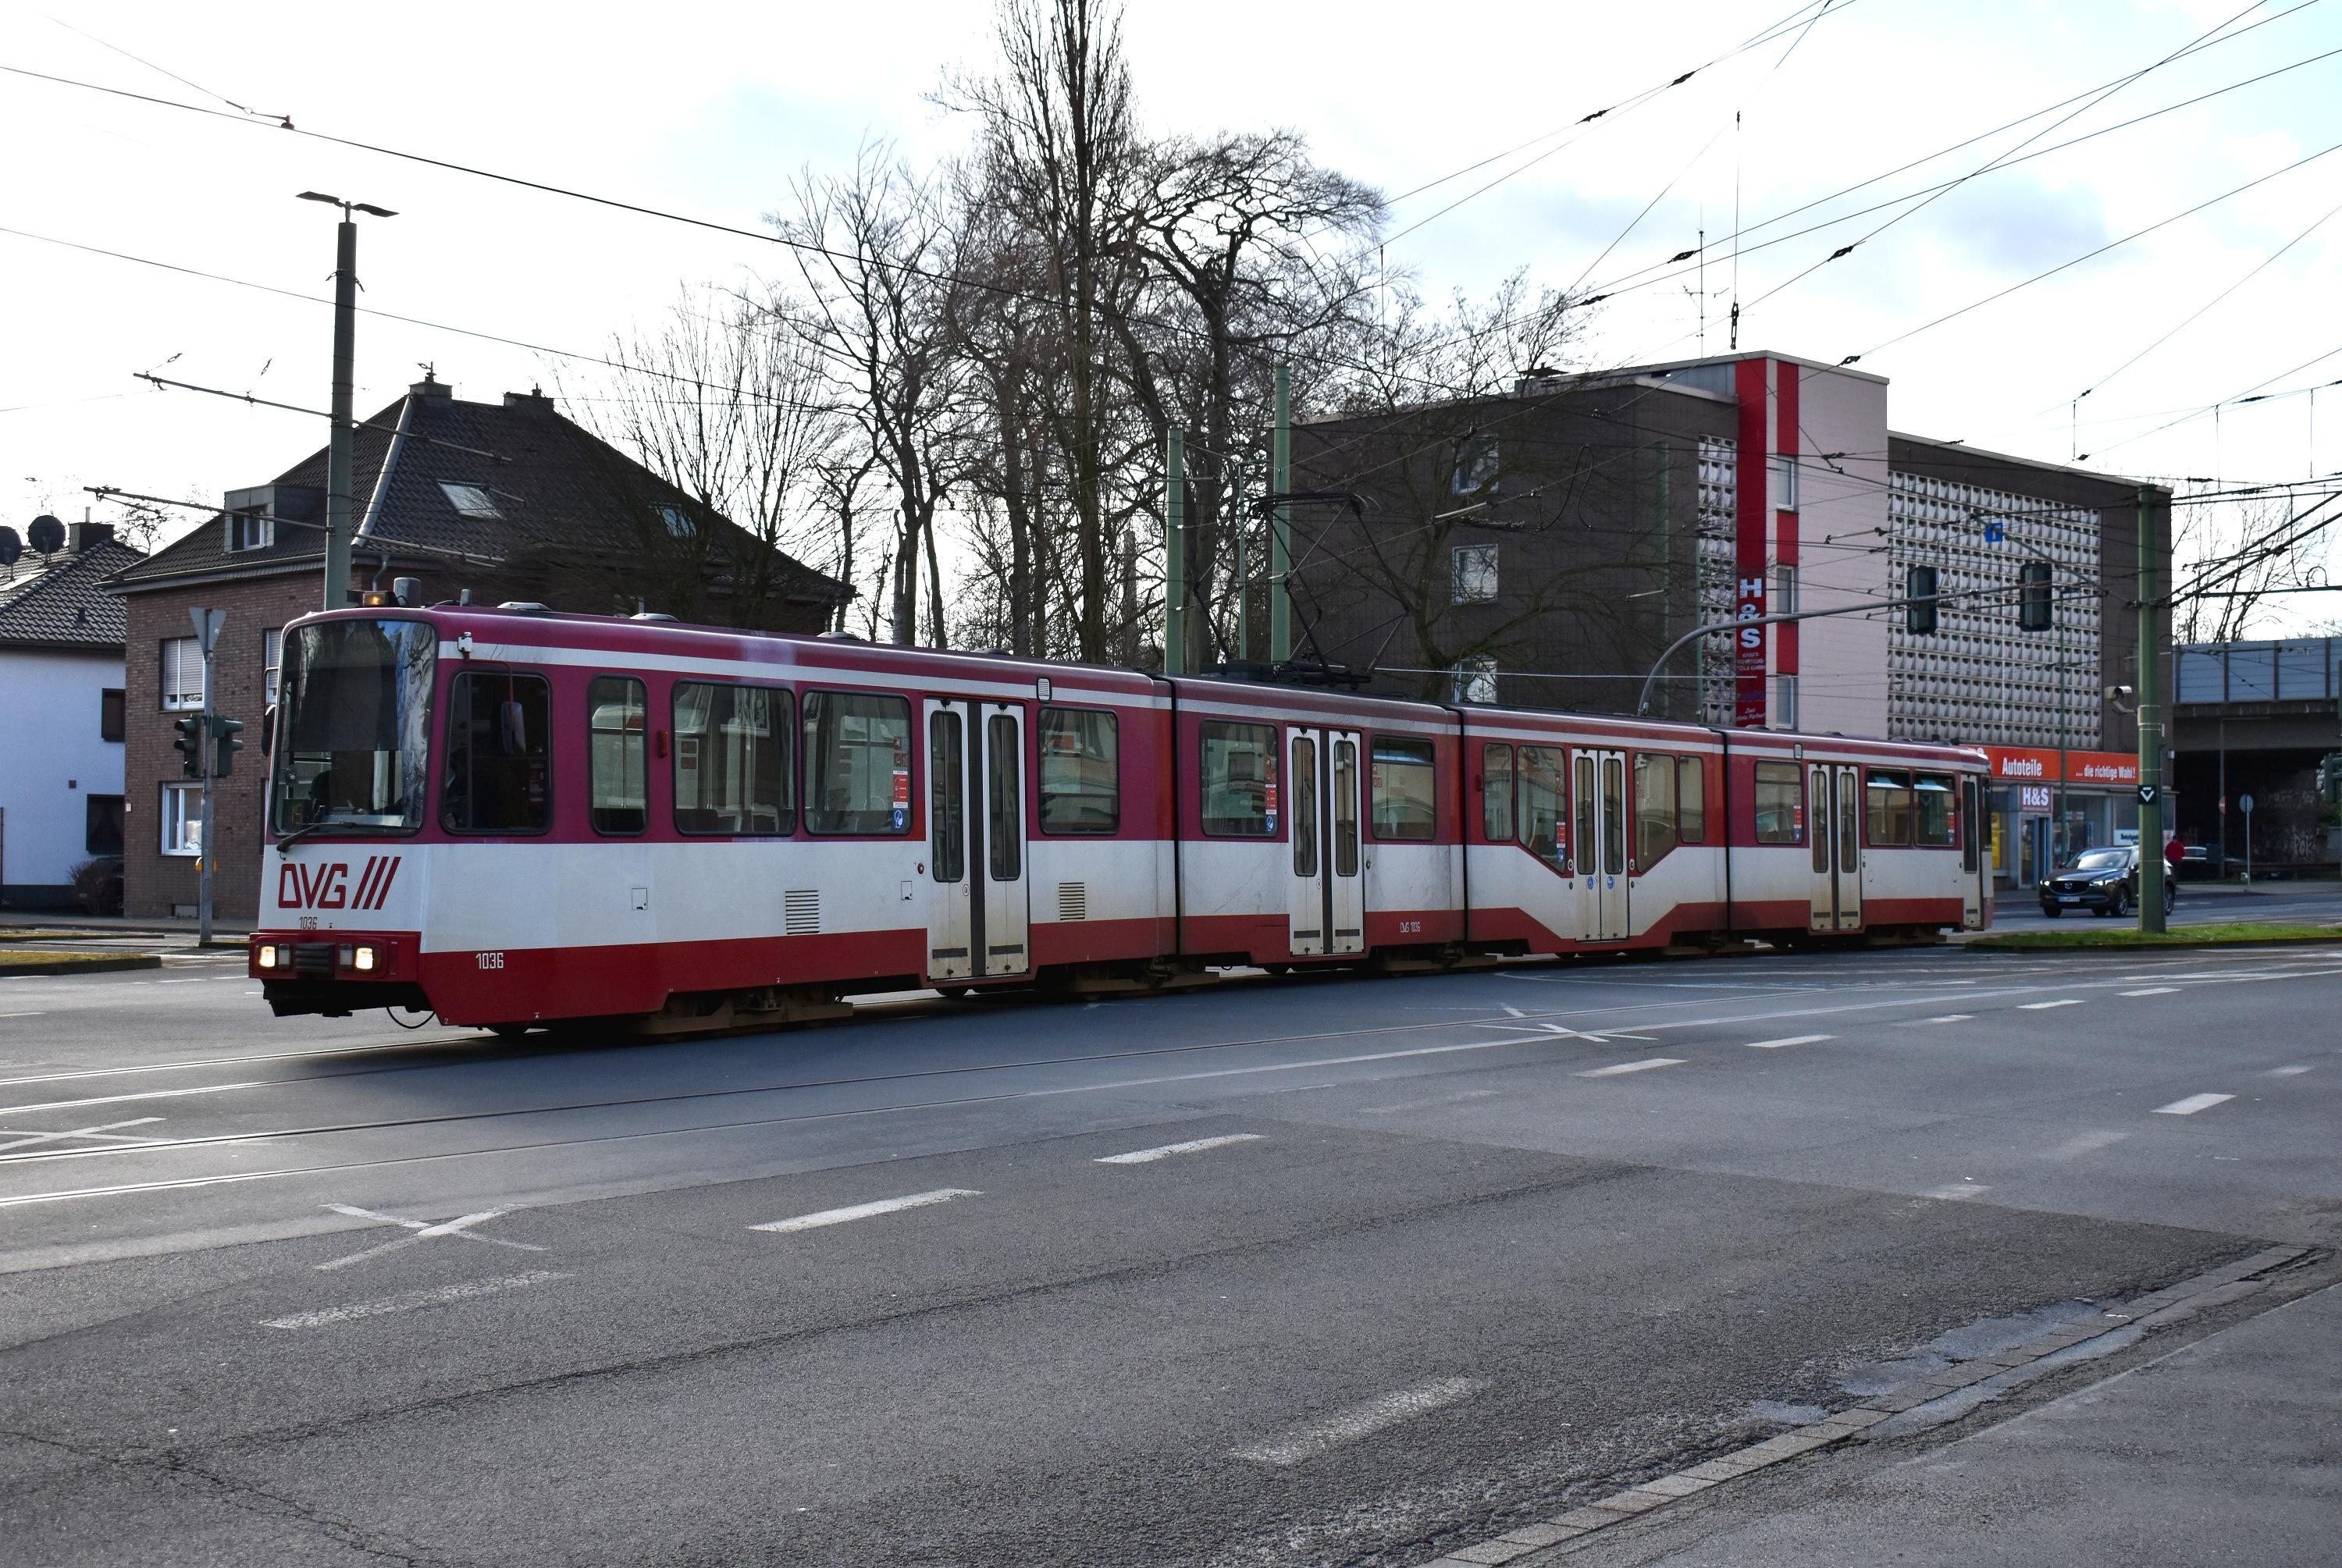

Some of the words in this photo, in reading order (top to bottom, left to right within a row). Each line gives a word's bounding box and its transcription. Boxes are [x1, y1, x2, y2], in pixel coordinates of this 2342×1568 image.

[2002, 757, 2042, 777] Autoteile
[2084, 764, 2094, 777] die
[2095, 765, 2117, 780] richtige
[2023, 787, 2048, 806] H&S
[299, 916, 318, 930] 1036
[475, 952, 504, 969] 1036
